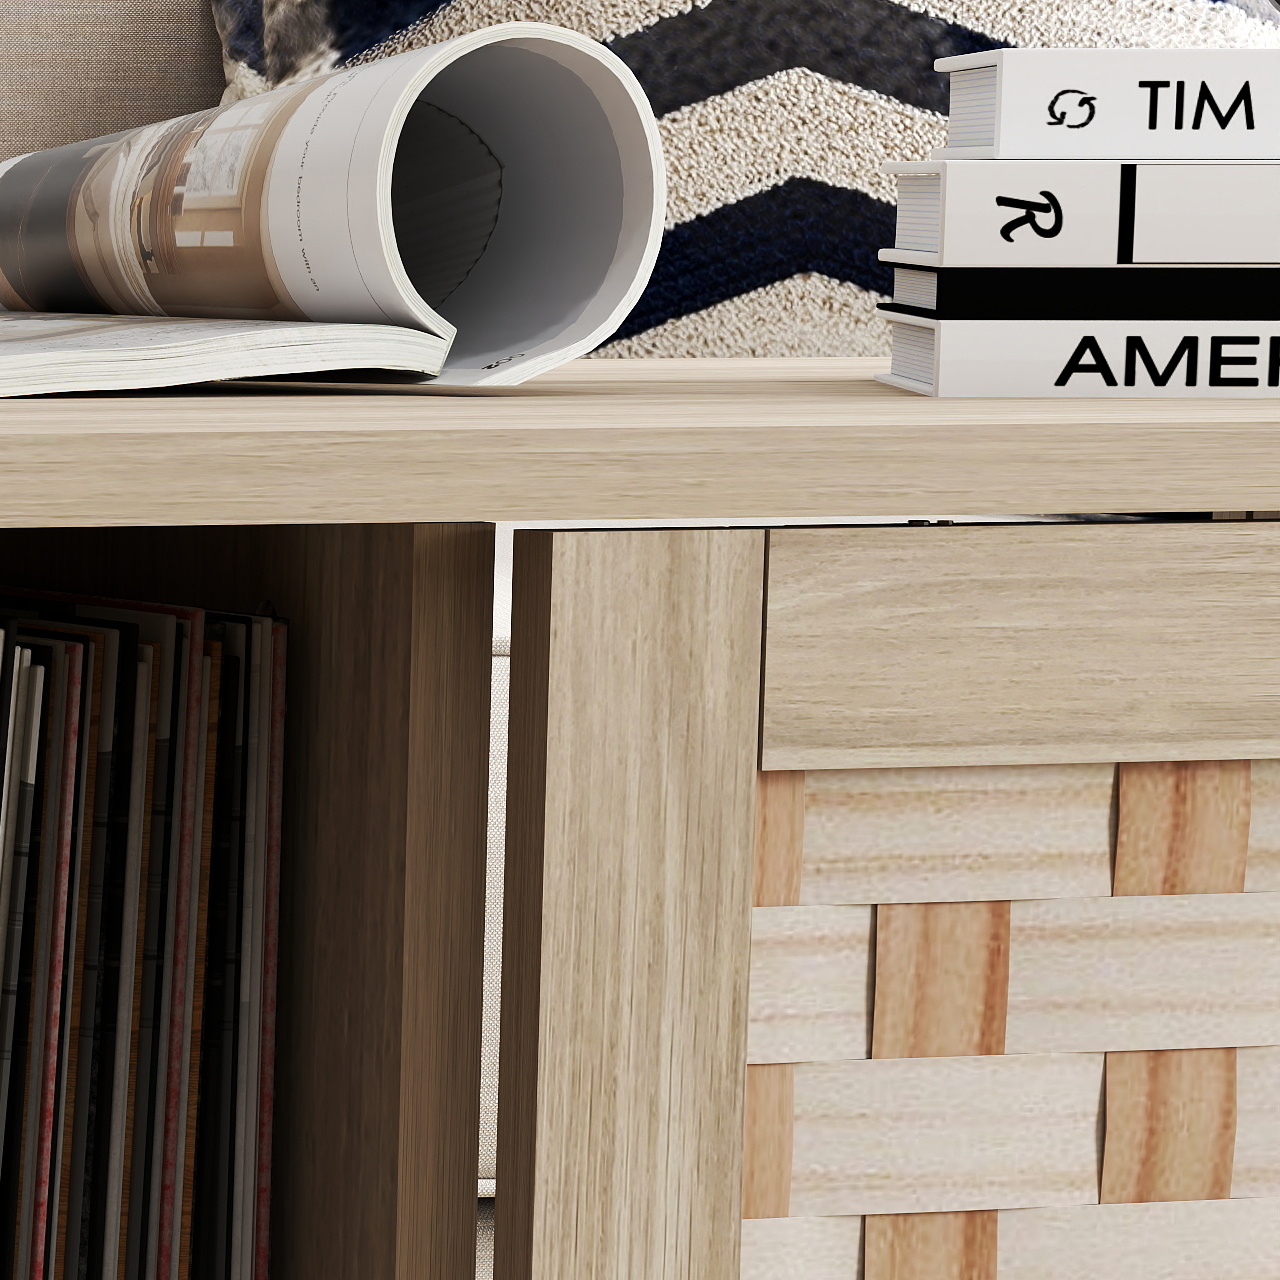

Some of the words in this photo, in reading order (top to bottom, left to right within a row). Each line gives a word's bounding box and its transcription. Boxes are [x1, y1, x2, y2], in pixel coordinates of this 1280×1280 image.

[1138, 80, 1255, 130] TIM
[300, 140, 310, 169] your
[995, 190, 1063, 242] R
[302, 248, 311, 273] with
[311, 278, 319, 291] an
[1055, 335, 1280, 387] AME
